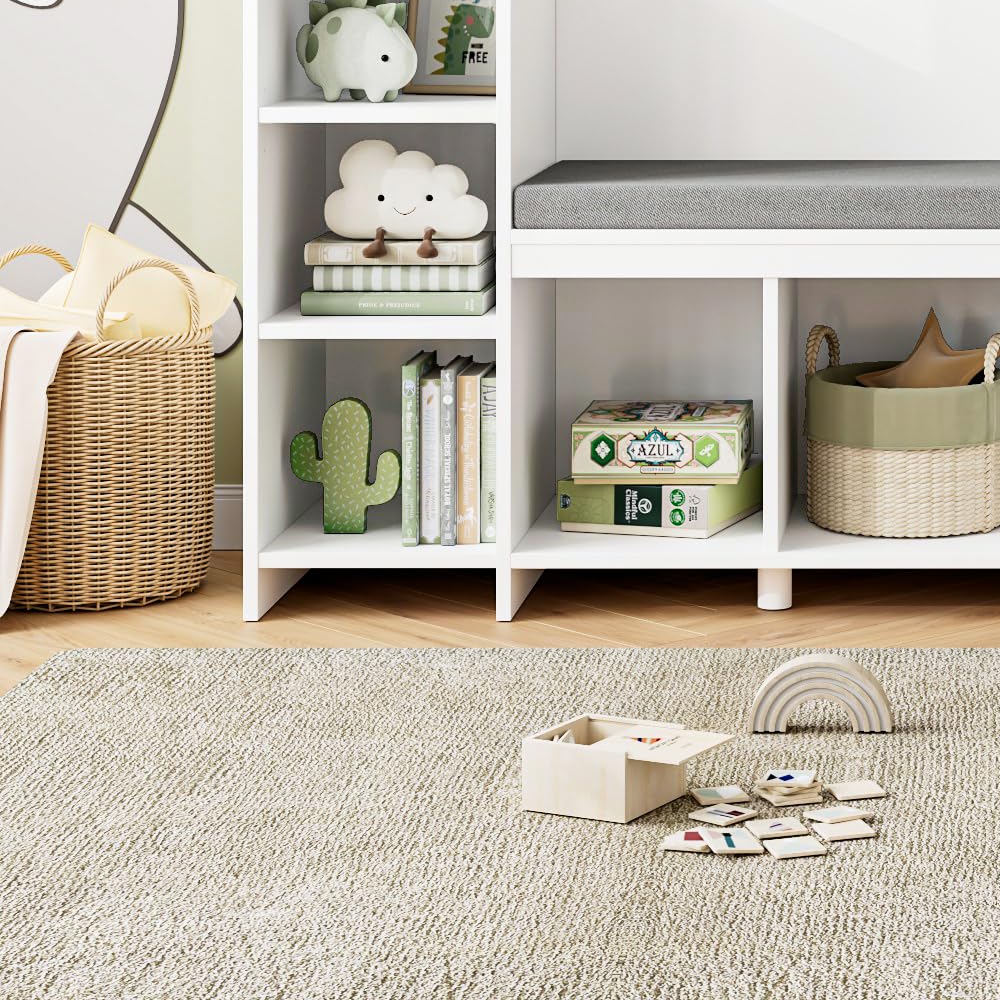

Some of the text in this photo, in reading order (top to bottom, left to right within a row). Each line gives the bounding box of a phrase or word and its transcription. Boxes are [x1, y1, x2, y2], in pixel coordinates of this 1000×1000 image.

[462, 51, 488, 63] FREE
[482, 384, 496, 418] AJAY
[637, 443, 674, 457] AZUL
